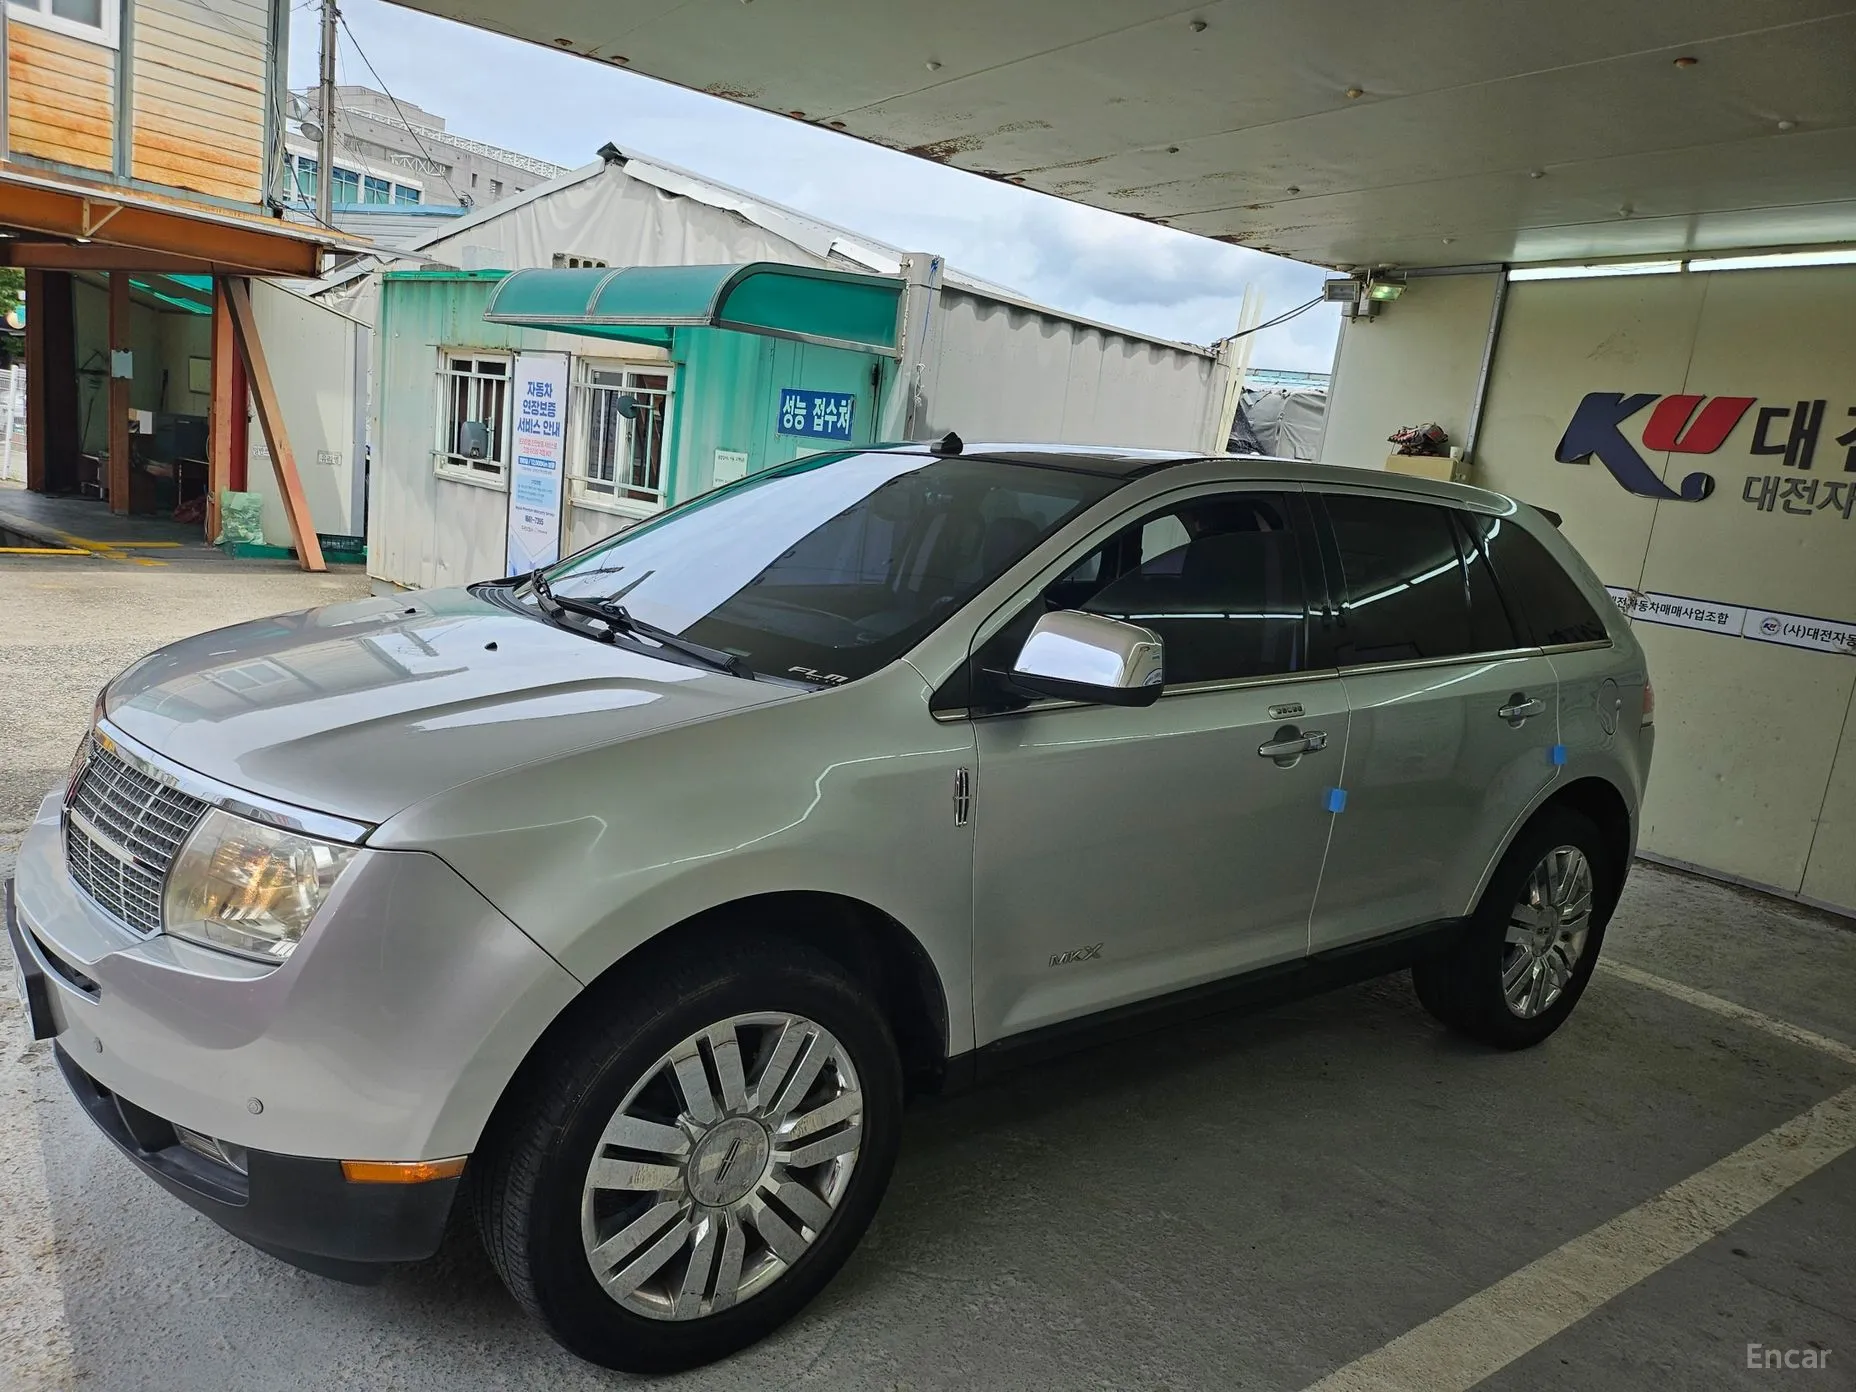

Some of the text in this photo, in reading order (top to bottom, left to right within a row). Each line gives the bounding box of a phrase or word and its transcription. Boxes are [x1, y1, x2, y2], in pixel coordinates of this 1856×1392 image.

[527, 381, 553, 398] 자동차
[523, 399, 556, 418] 연장보증
[783, 395, 851, 434] 성능 접수처
[517, 417, 561, 437] 서비스 안내
[1049, 942, 1104, 968] MKX
